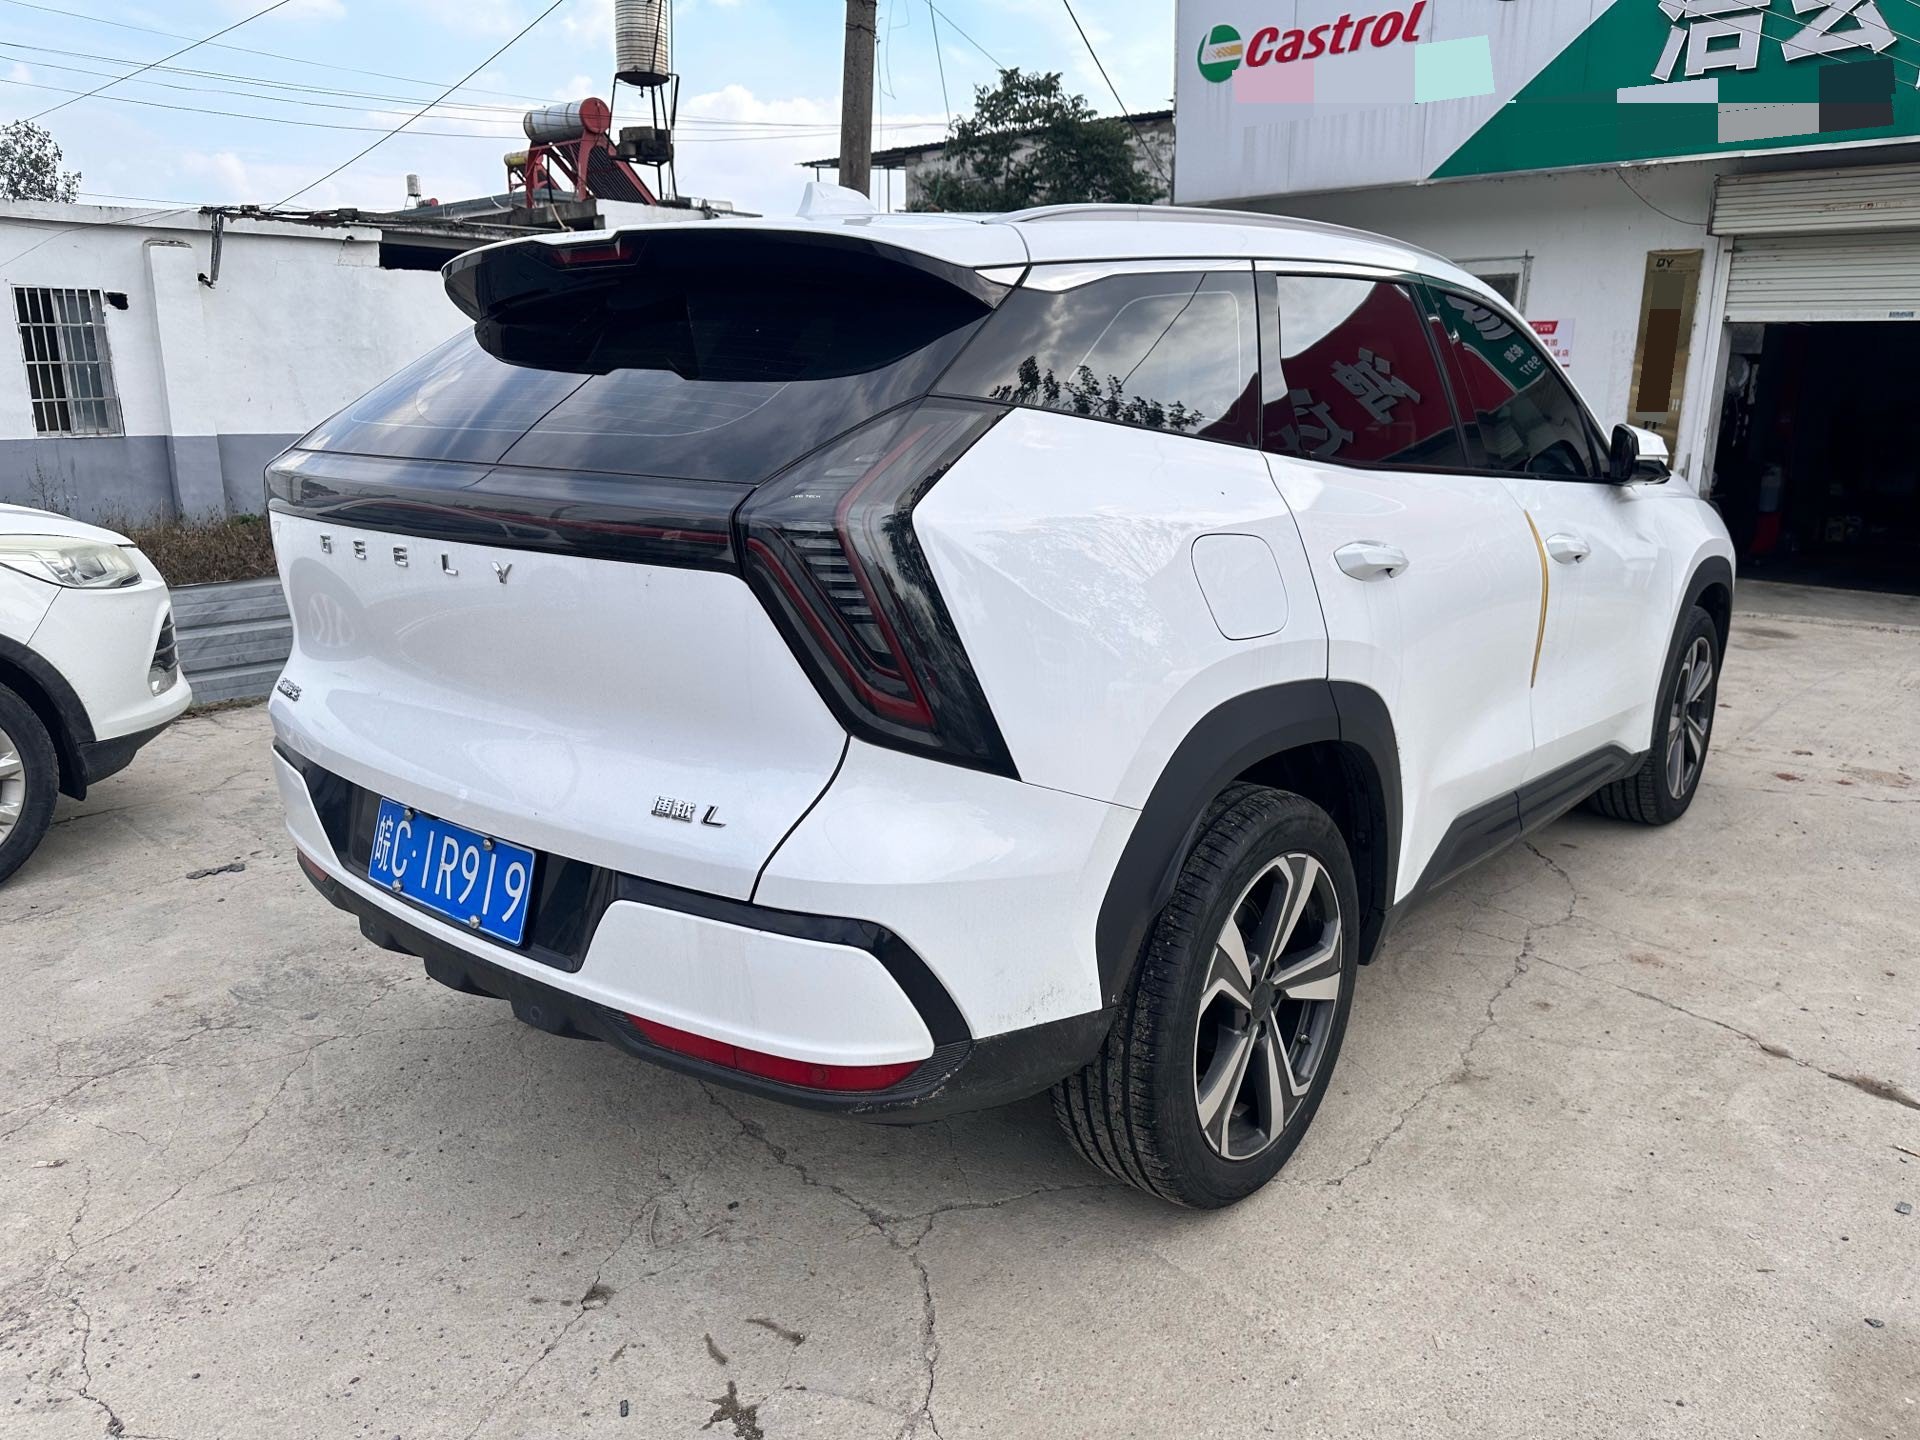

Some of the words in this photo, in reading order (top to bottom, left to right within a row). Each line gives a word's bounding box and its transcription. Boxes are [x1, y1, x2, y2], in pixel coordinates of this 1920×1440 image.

[1245, 0, 1428, 67] Castrol
[319, 533, 513, 585] GEELY
[701, 804, 727, 828] L
